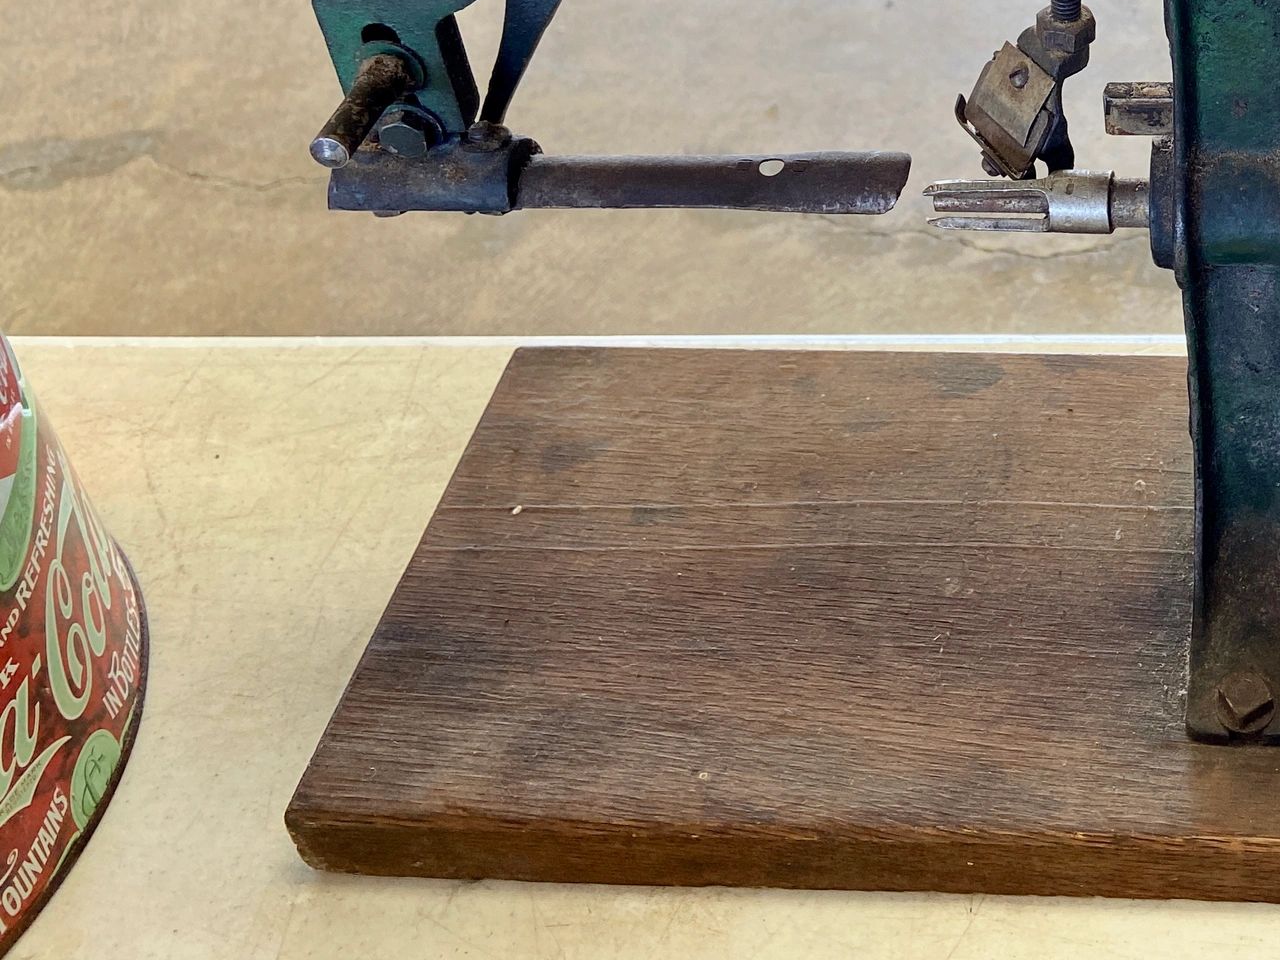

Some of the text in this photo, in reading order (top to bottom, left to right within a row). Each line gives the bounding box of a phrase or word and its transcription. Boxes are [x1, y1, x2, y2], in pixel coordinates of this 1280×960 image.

[0, 607, 20, 649] ND
[15, 443, 58, 612] REFRESHING
[102, 686, 123, 720] IN
[0, 786, 69, 933] OUNTAINS
